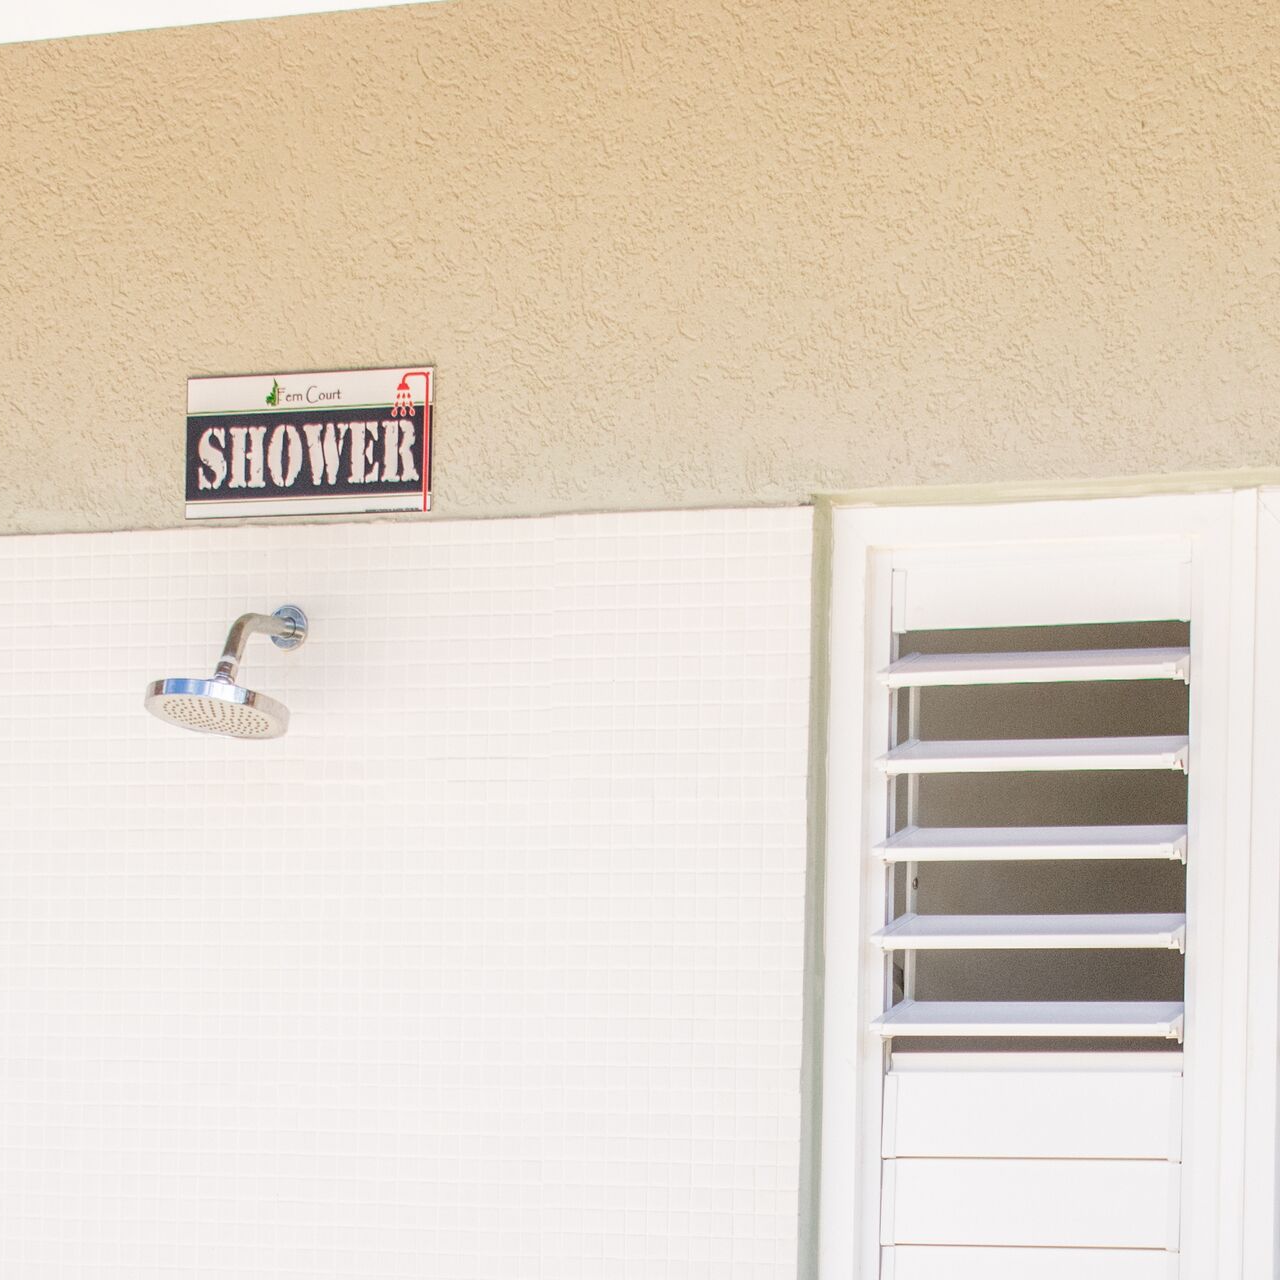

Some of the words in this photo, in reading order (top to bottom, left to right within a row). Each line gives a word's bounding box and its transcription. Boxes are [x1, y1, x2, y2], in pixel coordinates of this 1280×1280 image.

[273, 386, 303, 405] Fern
[305, 385, 342, 404] Court
[198, 419, 420, 490] SHOWER
